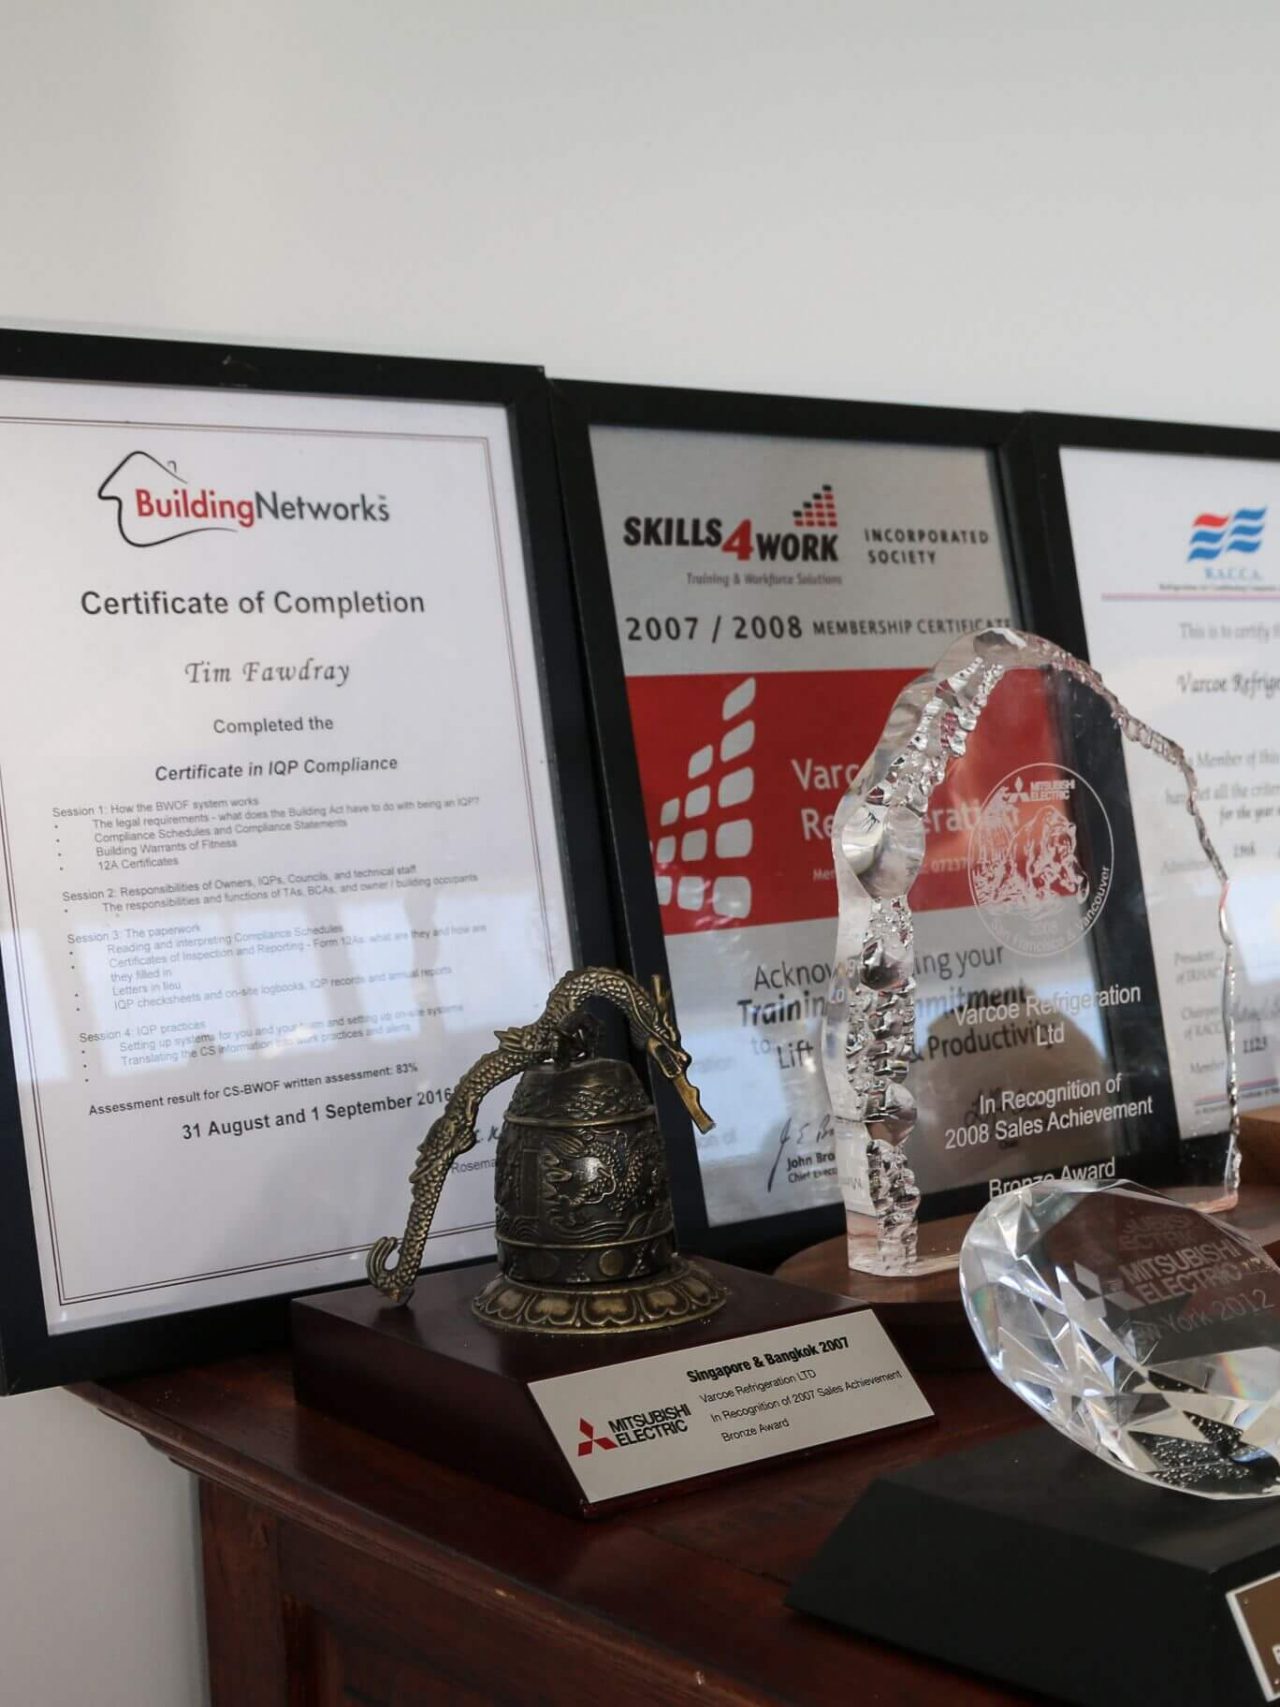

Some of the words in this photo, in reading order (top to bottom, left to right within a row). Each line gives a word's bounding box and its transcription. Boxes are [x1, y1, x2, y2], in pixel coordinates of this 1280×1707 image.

[136, 488, 390, 527] BuildingNetworks
[864, 528, 988, 545] INCORPORATED
[868, 549, 937, 565] SOCIETY
[686, 573, 730, 588] Training
[732, 573, 741, 585] &
[744, 573, 794, 587] Workforce
[797, 573, 842, 585] Solutions
[81, 591, 229, 616] Certificate
[239, 592, 266, 614] of
[274, 591, 425, 620] Completion
[626, 617, 698, 642] 2007
[712, 616, 720, 644] /
[734, 615, 802, 640] 2008
[813, 619, 912, 637] MEMBERSHIP
[184, 660, 232, 685] Tim
[242, 659, 351, 687] Fawdray
[1177, 671, 1227, 694] Varcoe
[213, 718, 304, 738] Completed
[308, 716, 334, 732] the
[155, 763, 244, 782] Certificate
[249, 763, 263, 777] in
[268, 760, 299, 777] IQP
[303, 756, 398, 776] Compliance
[791, 758, 860, 791] Varc
[52, 805, 95, 818] Session
[110, 804, 134, 815] How
[136, 802, 152, 813] the
[156, 800, 190, 812] BWOF
[192, 799, 228, 811] system
[230, 797, 260, 808] works
[94, 830, 156, 845] Compliance
[158, 826, 211, 840] Schedules
[214, 825, 232, 836] and
[235, 822, 291, 836] Compliance
[294, 818, 348, 831] Statements
[62, 889, 105, 902] Session
[120, 882, 200, 898] Responsibilities
[203, 879, 213, 890] of
[334, 869, 351, 880] and
[353, 865, 394, 878] technical
[397, 864, 417, 875] staff
[958, 946, 1004, 977] your
[737, 990, 829, 1028] Trainin
[953, 1003, 1020, 1026] Varcoe
[1026, 984, 1141, 1017] Refrigeration
[1036, 1022, 1065, 1047] Ltd
[777, 1040, 814, 1069] Lift
[88, 1097, 164, 1116] Assessment
[167, 1091, 201, 1105] result
[203, 1089, 220, 1100] for
[223, 1080, 281, 1098] CS-BWOF
[283, 1075, 322, 1089] written
[325, 1067, 394, 1084] assessment:
[396, 1062, 418, 1074] 83%
[980, 1095, 996, 1115] In
[1001, 1078, 1101, 1111] Recognition
[1105, 1072, 1122, 1093] of
[182, 1123, 200, 1140] 31
[208, 1114, 271, 1137] August
[275, 1108, 305, 1127] and
[311, 1106, 319, 1121] 1
[325, 1094, 413, 1120] September
[416, 1088, 451, 1107] 2016
[945, 1123, 989, 1150] 2008
[995, 1116, 1043, 1140] Sales
[1046, 1096, 1153, 1131] Achievement
[787, 1156, 812, 1171] John
[816, 1152, 836, 1163] Bro
[1060, 1156, 1116, 1182] Award
[1119, 1238, 1242, 1284] MITSUBISHI
[1135, 1260, 1242, 1305] ELECTRIC
[1212, 1289, 1276, 1321] 2012
[686, 1360, 752, 1383] Singapore
[752, 1356, 765, 1368] &
[764, 1343, 819, 1365] Bangkok
[818, 1336, 849, 1353] 2007
[699, 1388, 735, 1404] Varcoe
[735, 1374, 796, 1395] Refrigeration
[797, 1369, 817, 1381] LTD
[711, 1412, 722, 1423] In
[722, 1399, 781, 1420] Recognition
[781, 1396, 792, 1406] of
[792, 1390, 816, 1403] 2007
[817, 1385, 844, 1398] Sales
[845, 1370, 903, 1390] Achievement
[608, 1403, 692, 1433] MITSUBISHI
[721, 1426, 758, 1442] Bronze
[759, 1417, 790, 1431] Award
[615, 1419, 688, 1447] ELECTRIC
